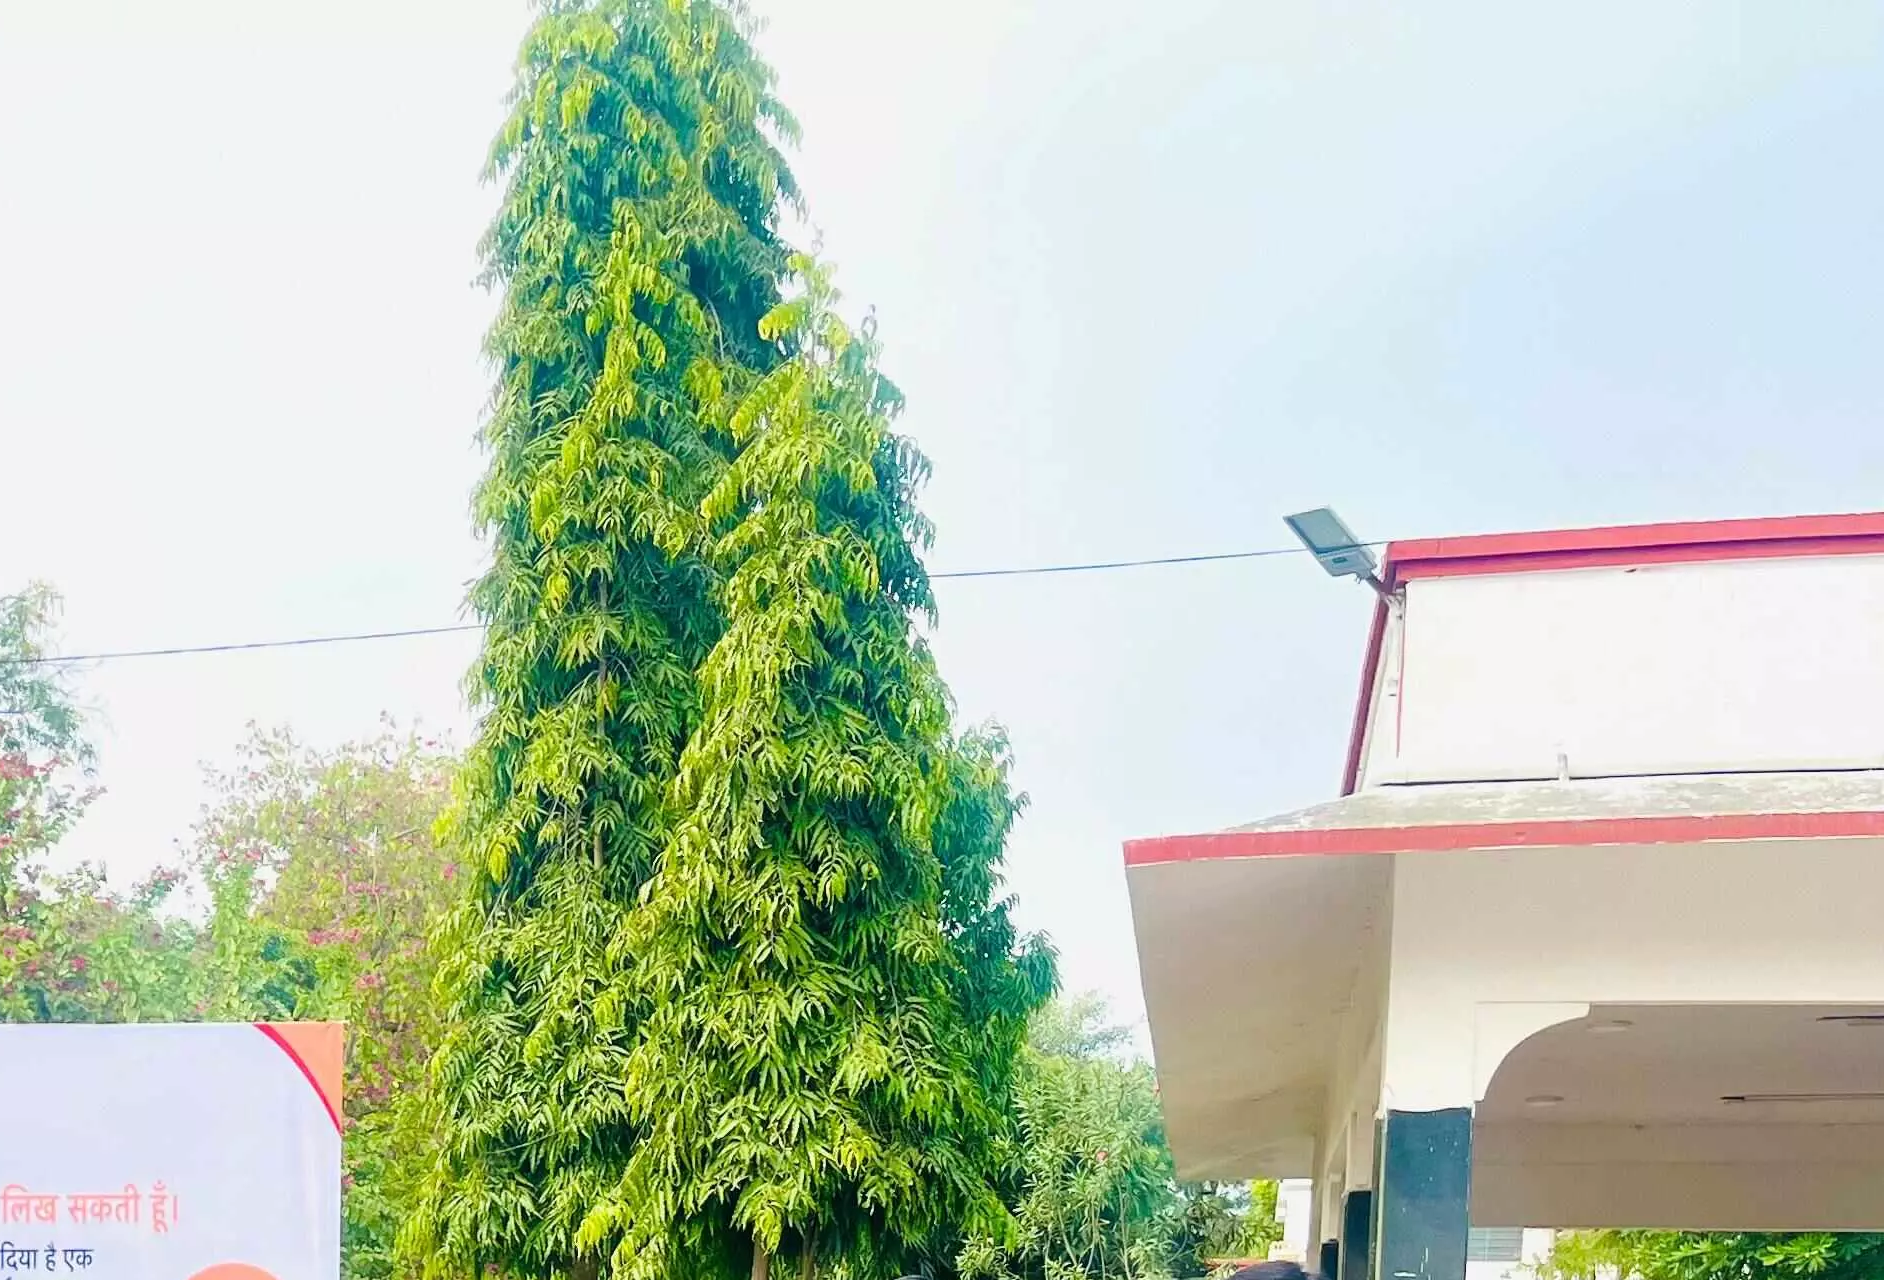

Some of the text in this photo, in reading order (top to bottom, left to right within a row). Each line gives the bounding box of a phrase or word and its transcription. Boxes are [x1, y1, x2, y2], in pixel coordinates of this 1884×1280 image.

[1, 1183, 59, 1223] लिख
[67, 1183, 141, 1223] सकती
[0, 1241, 39, 1271] दिया
[44, 1241, 57, 1272] है
[62, 1249, 95, 1272] एक
